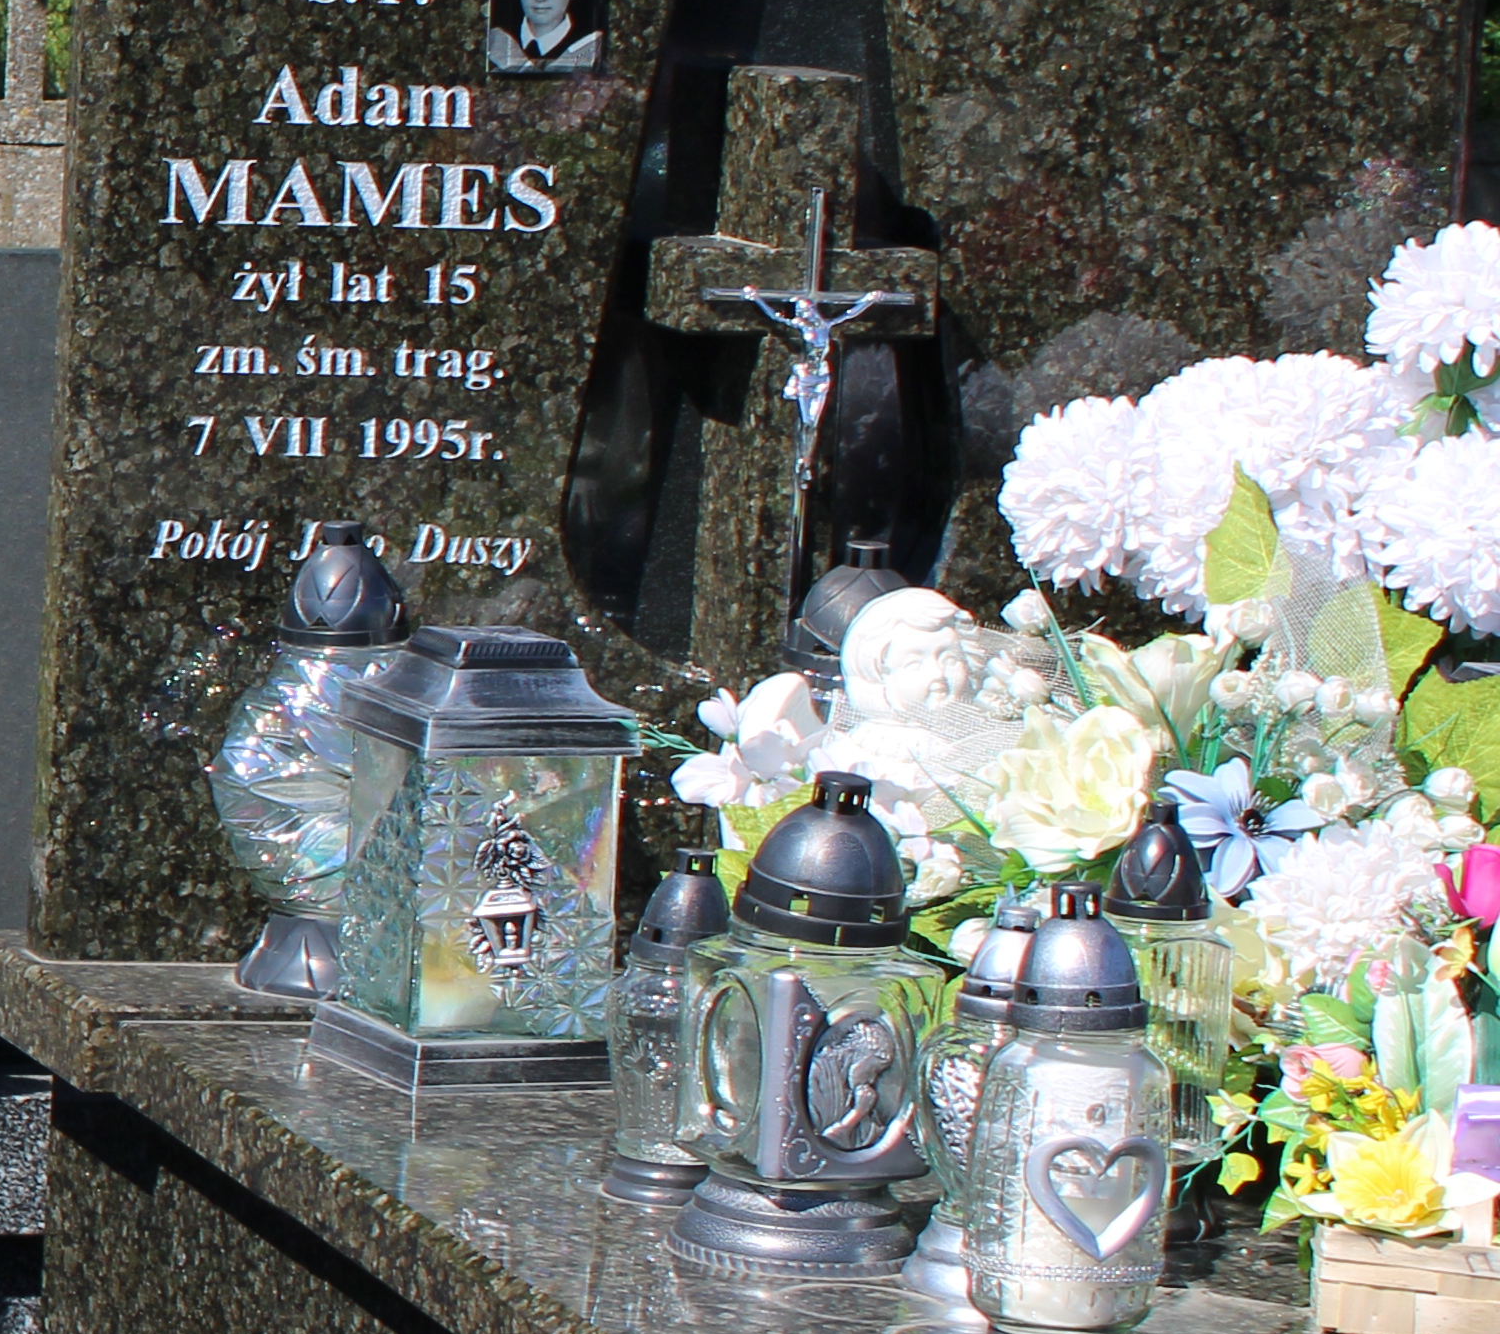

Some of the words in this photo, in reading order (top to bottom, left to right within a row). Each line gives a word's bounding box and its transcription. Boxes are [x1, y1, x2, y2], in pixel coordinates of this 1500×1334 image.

[254, 65, 473, 128] Adam
[160, 158, 558, 231] MAMES
[232, 262, 302, 311] żył
[330, 263, 392, 303] lat
[424, 265, 478, 304] 15
[195, 343, 278, 375] zm.
[296, 335, 376, 375] śm.
[394, 339, 505, 390] trag.
[187, 415, 215, 455] 7
[244, 417, 327, 458] VII
[359, 417, 505, 460] 1995r.
[150, 520, 269, 571] Pokój
[290, 521, 384, 561] Jo
[409, 523, 533, 572] Duszy
